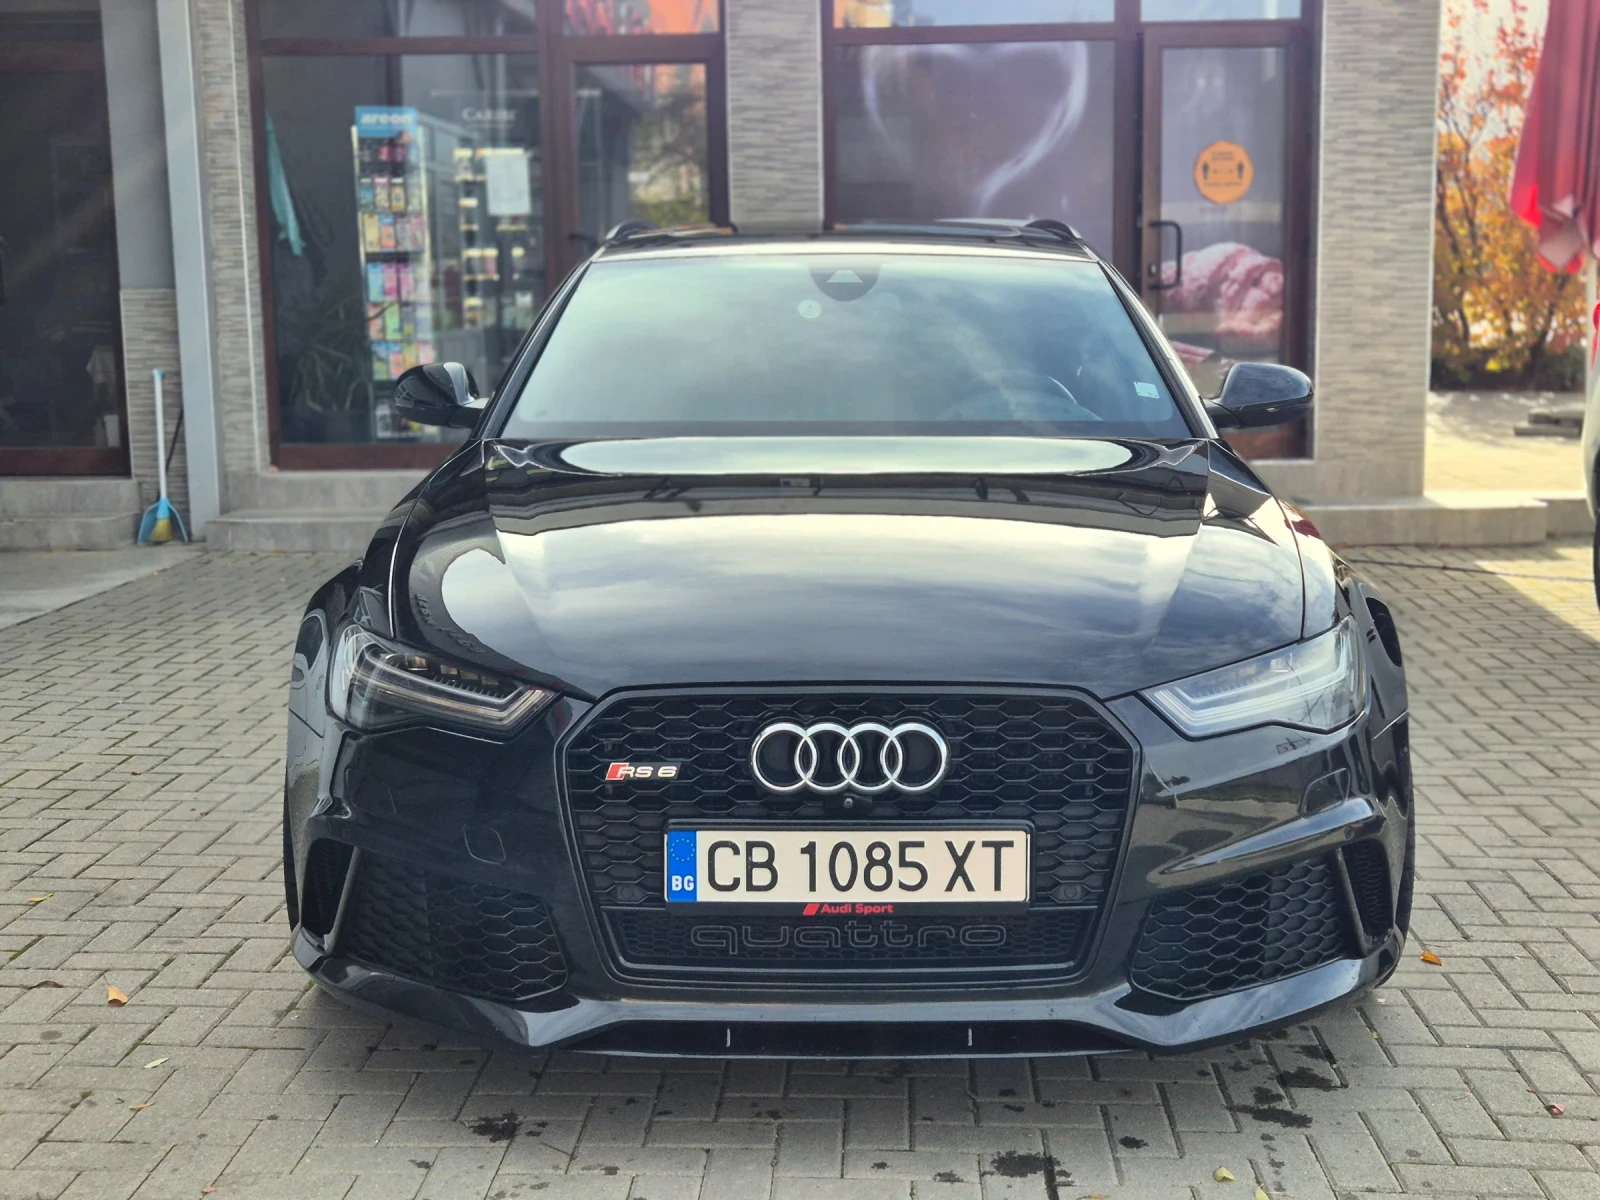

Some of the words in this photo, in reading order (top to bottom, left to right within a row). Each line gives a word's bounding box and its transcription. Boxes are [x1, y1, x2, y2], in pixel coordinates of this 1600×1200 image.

[611, 764, 653, 779] RS
[657, 765, 678, 778] 6
[707, 840, 779, 892] CB
[800, 840, 929, 893] 1085
[943, 840, 1015, 892] XT
[671, 875, 695, 891] BG
[820, 903, 852, 914] Audi
[855, 903, 894, 915] Sport
[690, 919, 1007, 955] quattro
